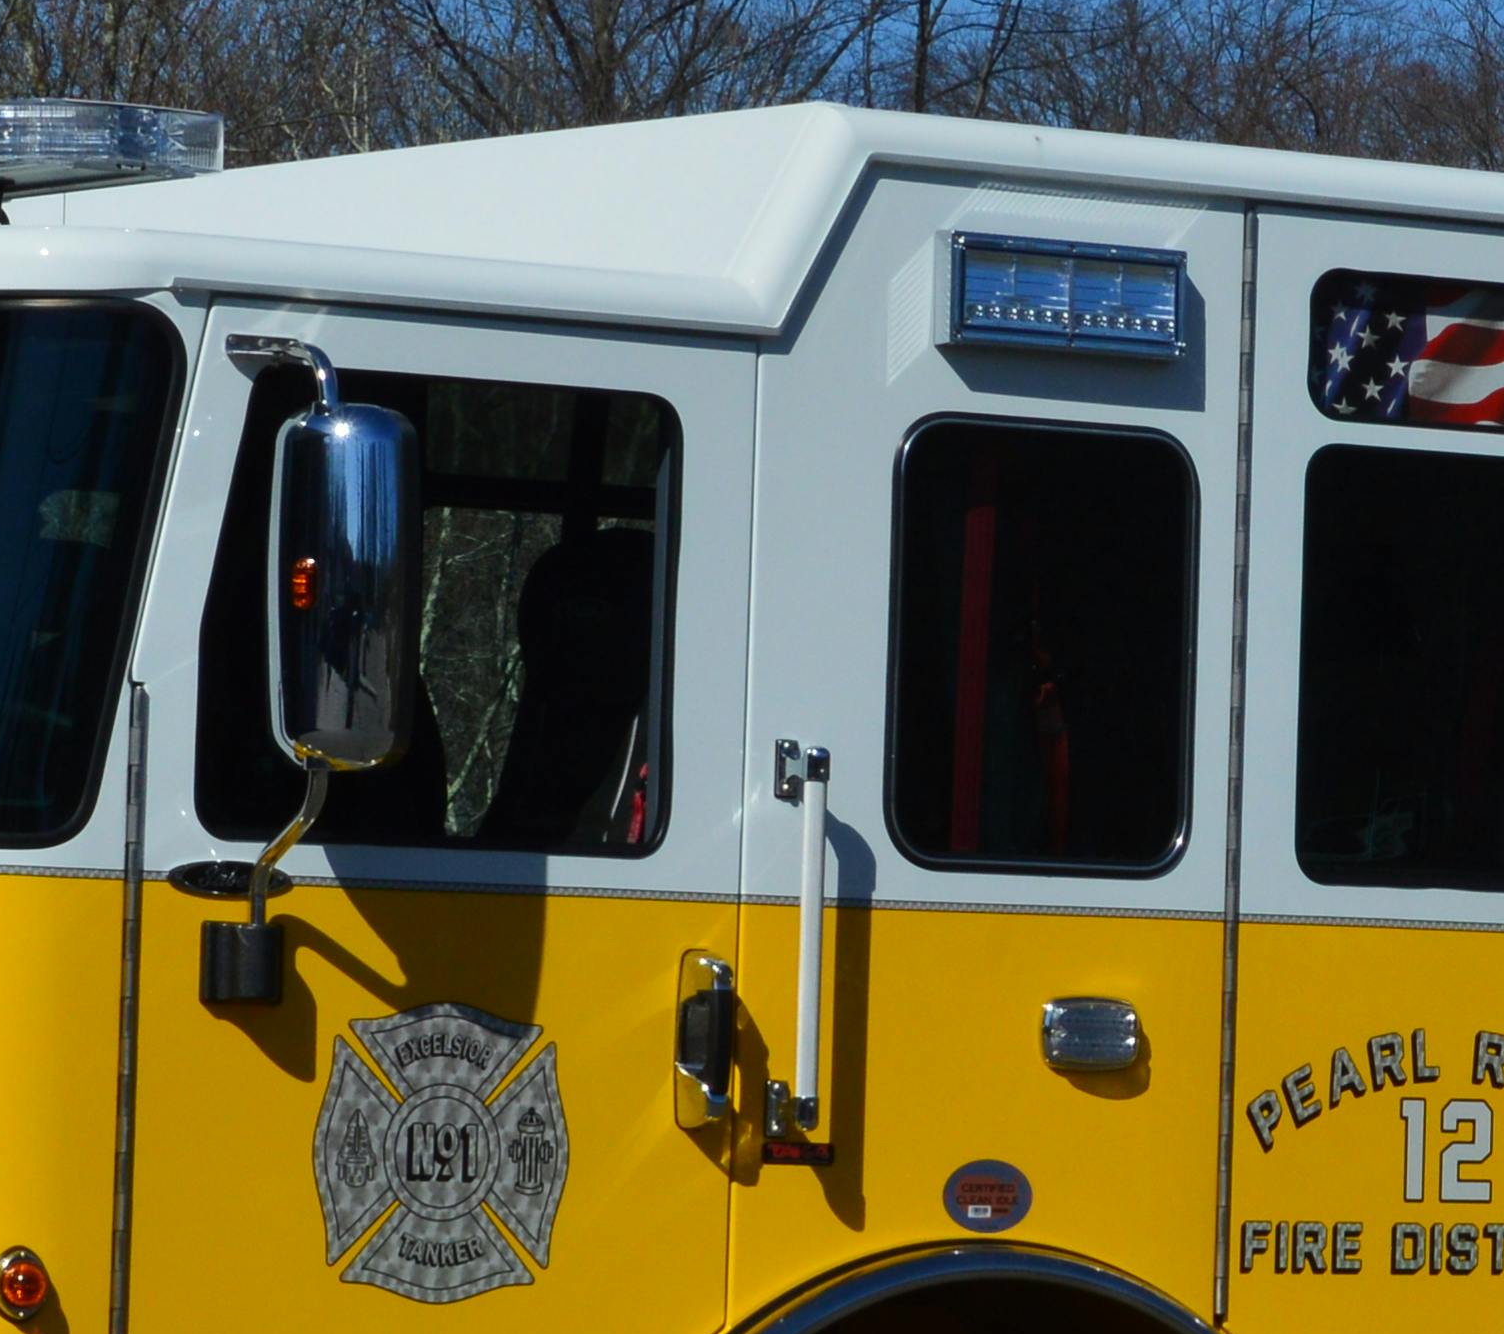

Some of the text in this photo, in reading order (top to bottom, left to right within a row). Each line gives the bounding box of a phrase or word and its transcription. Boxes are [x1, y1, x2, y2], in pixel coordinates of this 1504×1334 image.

[395, 1033, 494, 1070] EXCELSIOR
[1246, 1029, 1441, 1153] PEARL
[1399, 1097, 1493, 1203] 12
[398, 1232, 486, 1267] TANKER
[1239, 1220, 1364, 1275] FIRE
